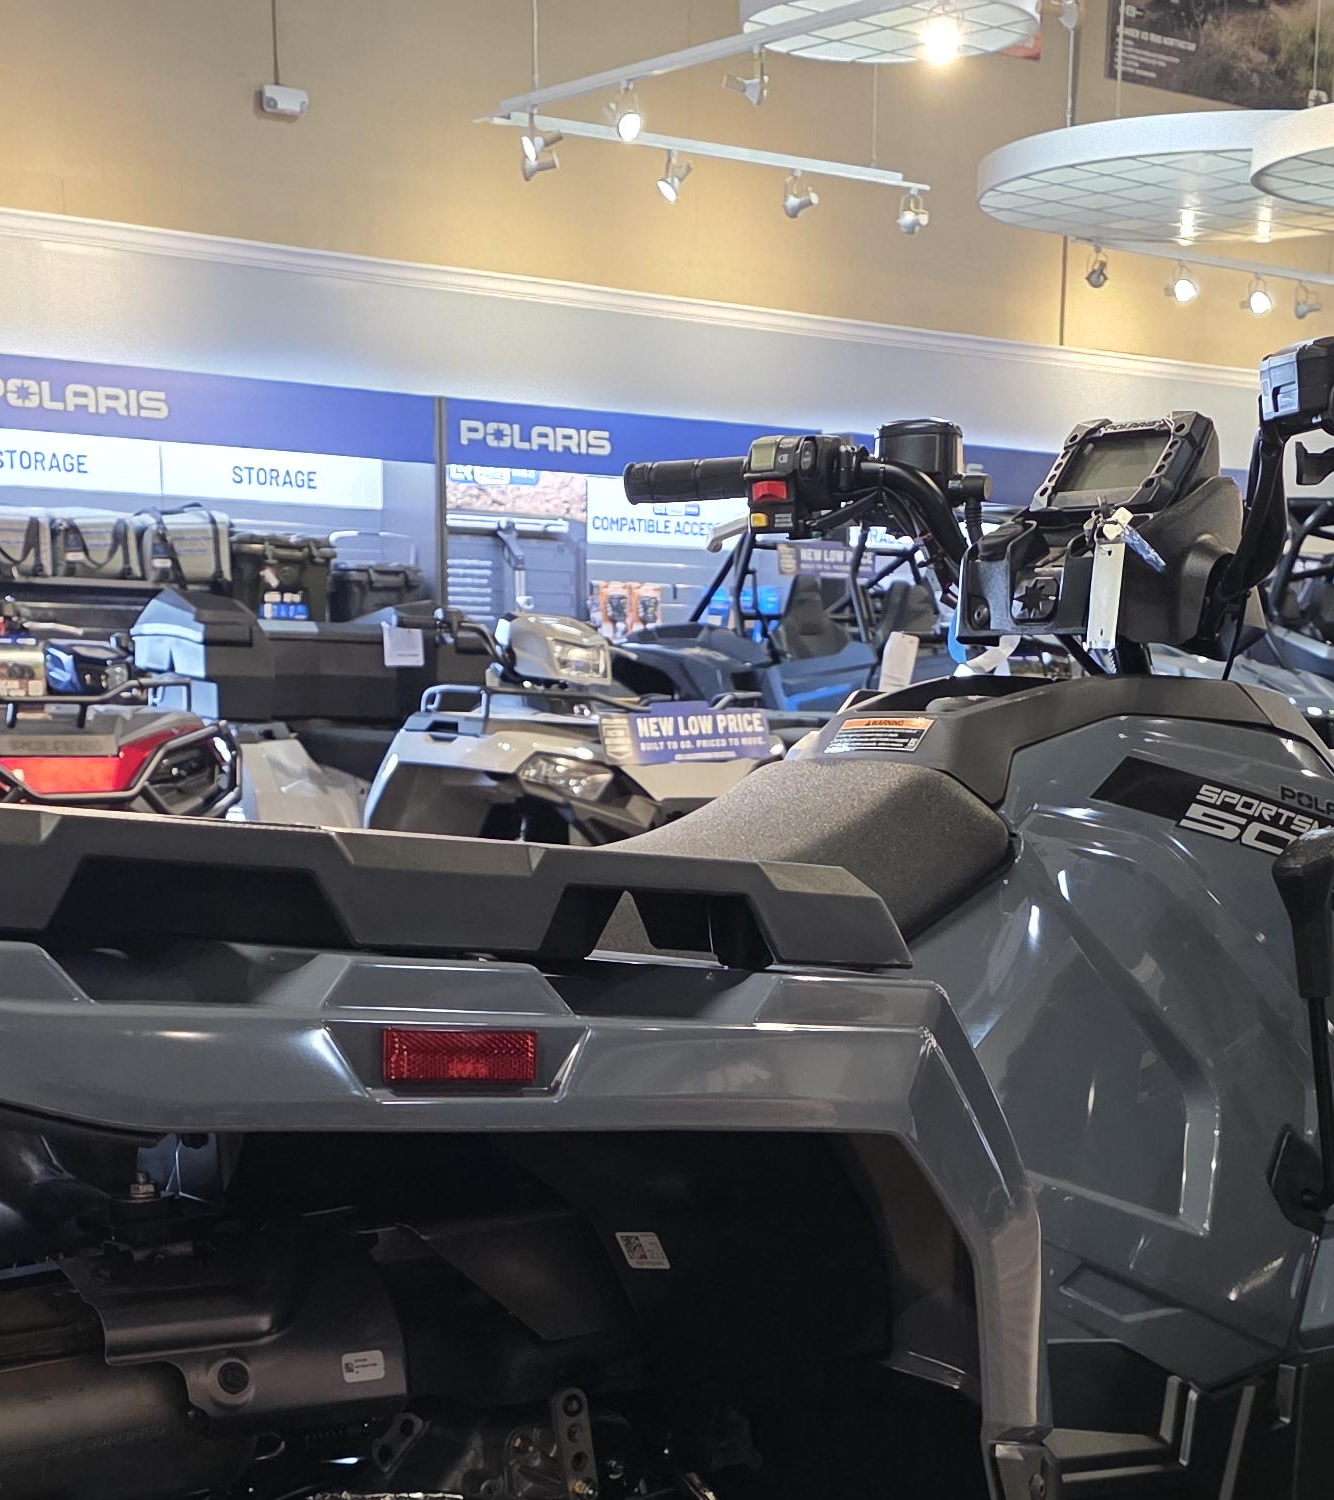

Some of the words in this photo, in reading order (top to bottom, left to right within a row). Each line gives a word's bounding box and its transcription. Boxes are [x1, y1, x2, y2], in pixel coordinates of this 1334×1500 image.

[1105, 420, 1157, 432] POLARIS
[459, 419, 612, 456] POLARIS
[231, 465, 318, 490] STORAGE
[592, 516, 671, 535] COMPATIBLE
[636, 716, 674, 738] NEW
[677, 714, 713, 736] LOW
[716, 712, 764, 735] PRICE
[871, 719, 904, 727] WARNING
[696, 738, 727, 749] PRICED
